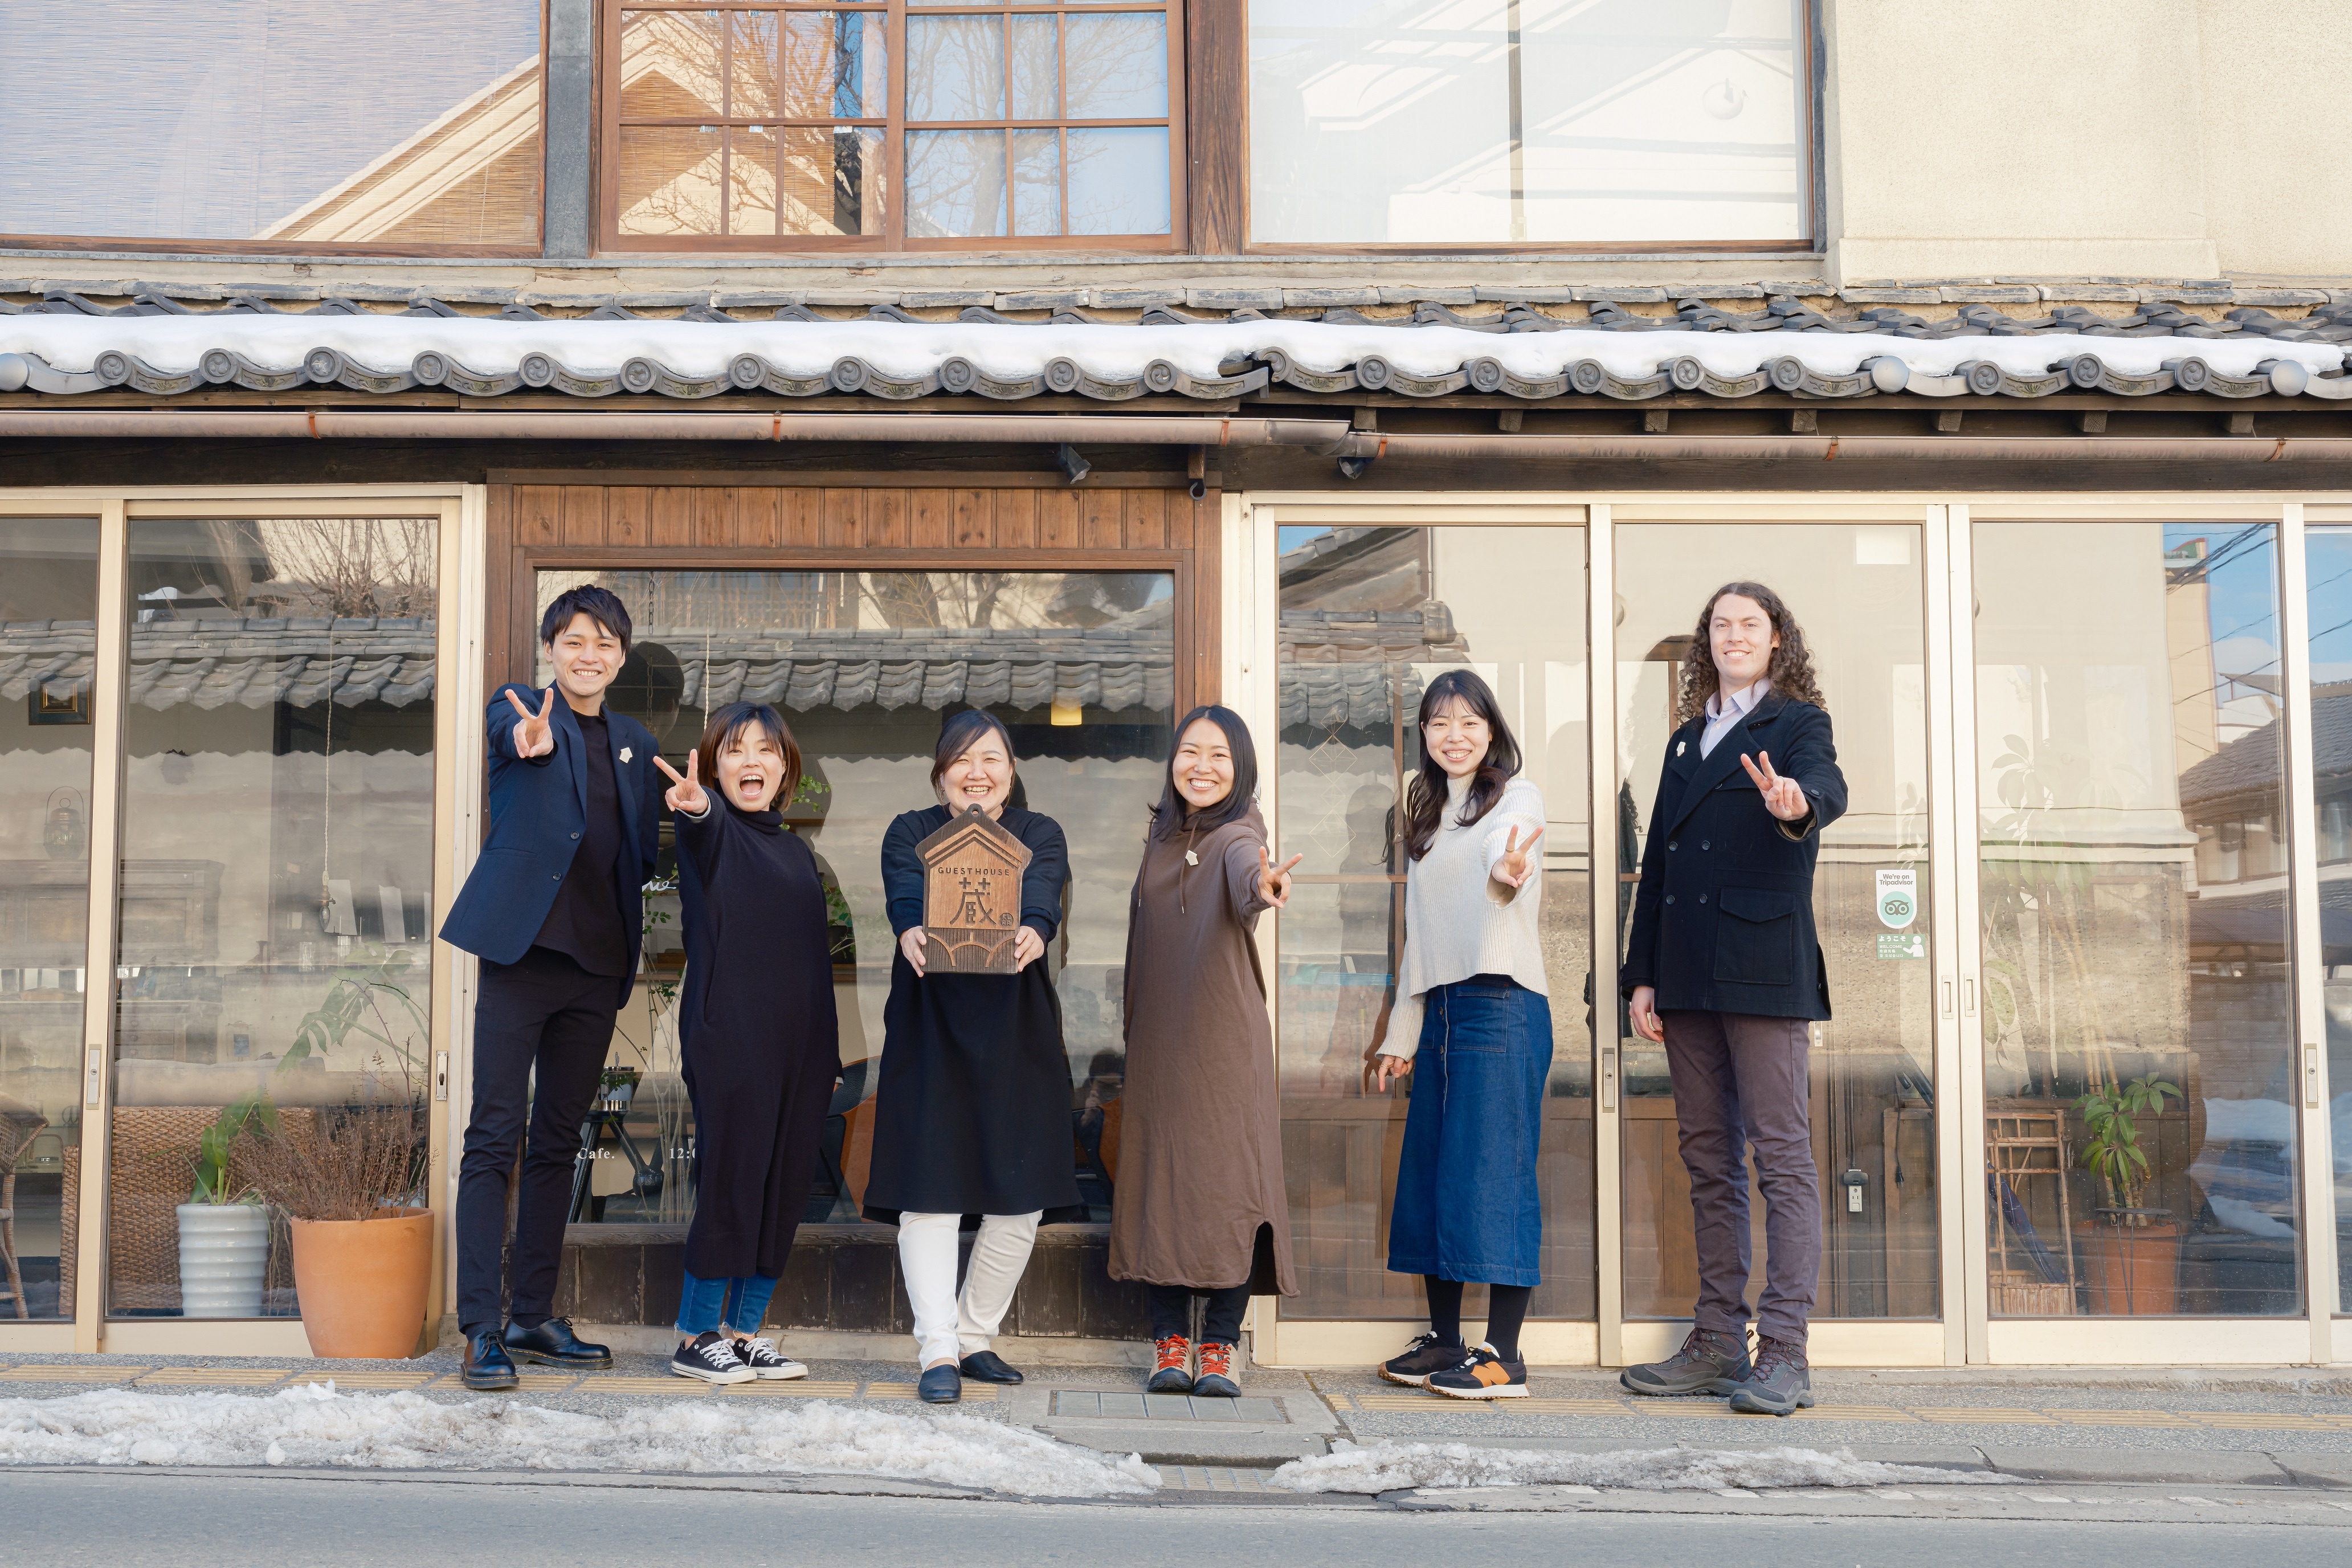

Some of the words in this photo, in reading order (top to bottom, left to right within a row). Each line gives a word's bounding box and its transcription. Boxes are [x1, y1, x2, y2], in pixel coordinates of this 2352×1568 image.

[938, 867, 1010, 876] GUESTHOUSE
[949, 877, 997, 926] 蔵
[577, 1148, 615, 1159] Cafe.
